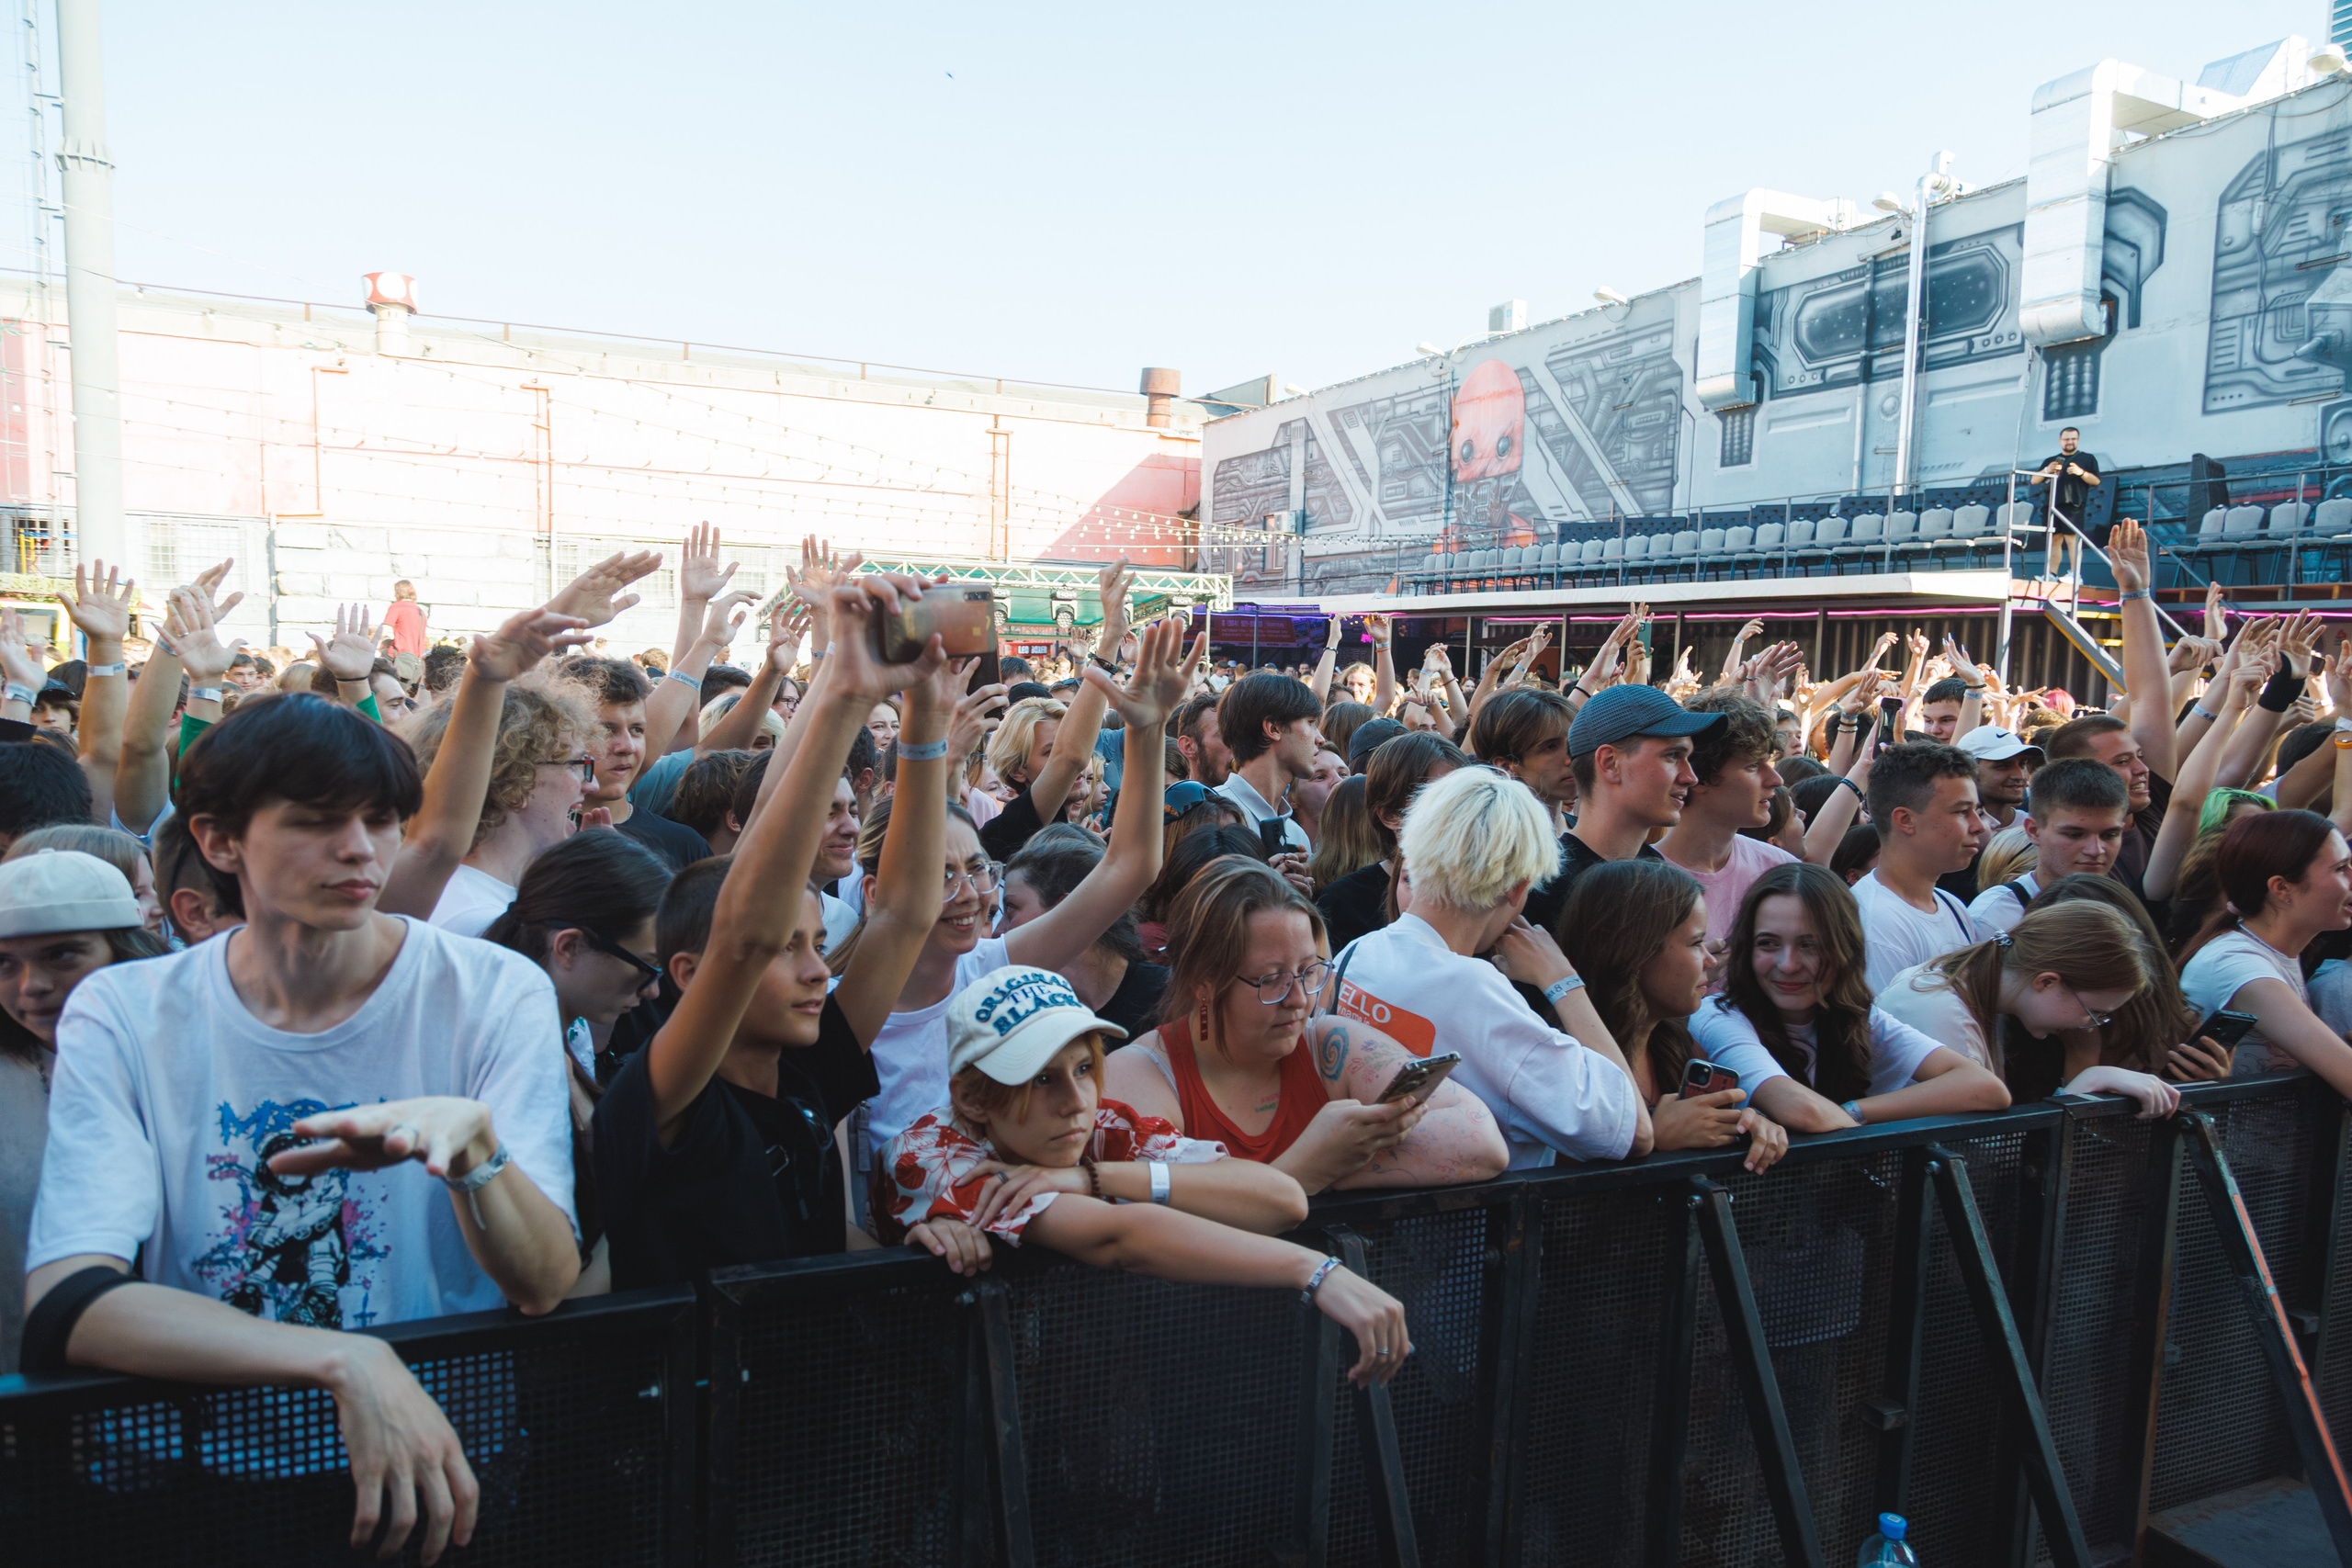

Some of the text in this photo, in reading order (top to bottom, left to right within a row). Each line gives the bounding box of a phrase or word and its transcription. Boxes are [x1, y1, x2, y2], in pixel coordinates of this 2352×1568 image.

[993, 992, 1082, 1036] BLACK
[1007, 985, 1052, 1005] THE
[1339, 982, 1392, 1023] ELLO
